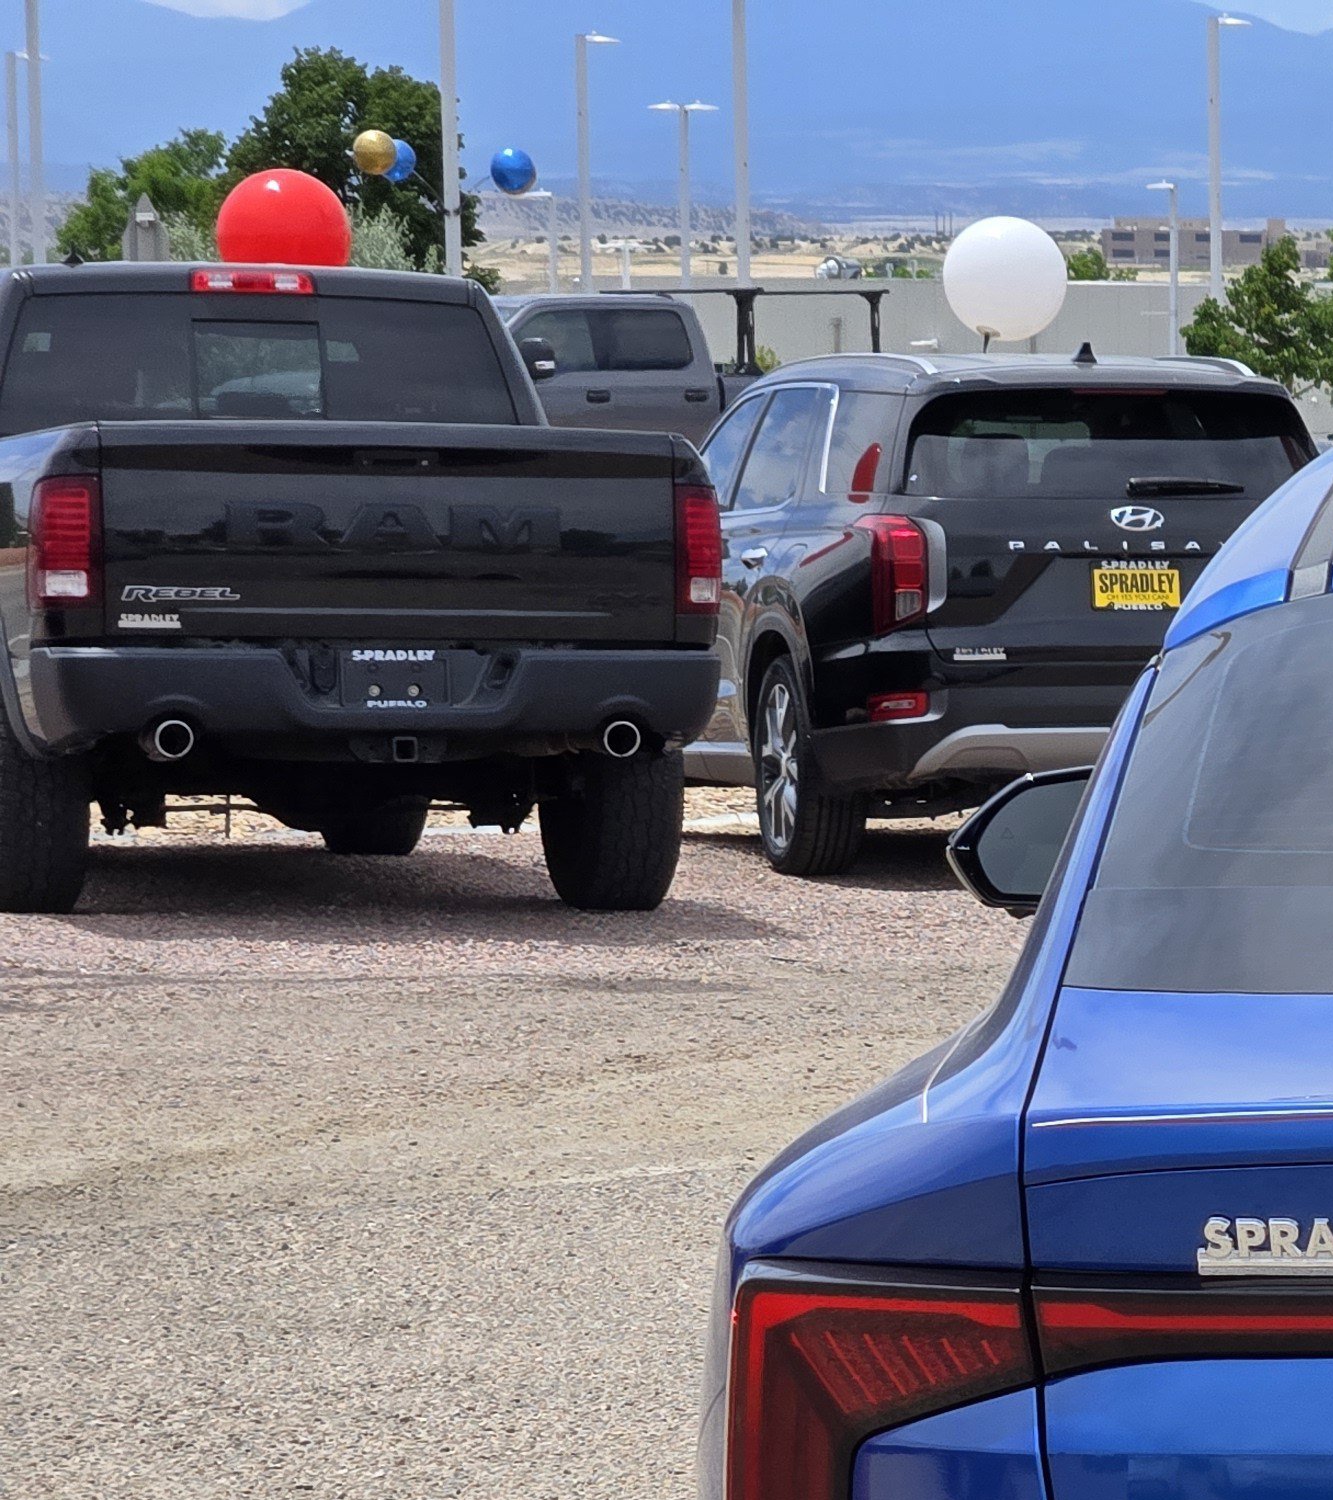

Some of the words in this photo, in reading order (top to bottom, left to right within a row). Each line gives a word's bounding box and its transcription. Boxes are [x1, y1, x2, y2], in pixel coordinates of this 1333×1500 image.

[223, 501, 562, 550] RAM
[1008, 540, 1225, 551] PALISA
[1101, 560, 1170, 570] SPRADLEY
[1098, 572, 1175, 594] SPRADLEY
[121, 585, 241, 602] REBEL
[119, 613, 180, 624] SPRADLEY
[351, 650, 436, 662] SPRADLEY
[366, 700, 429, 709] PUEBLO
